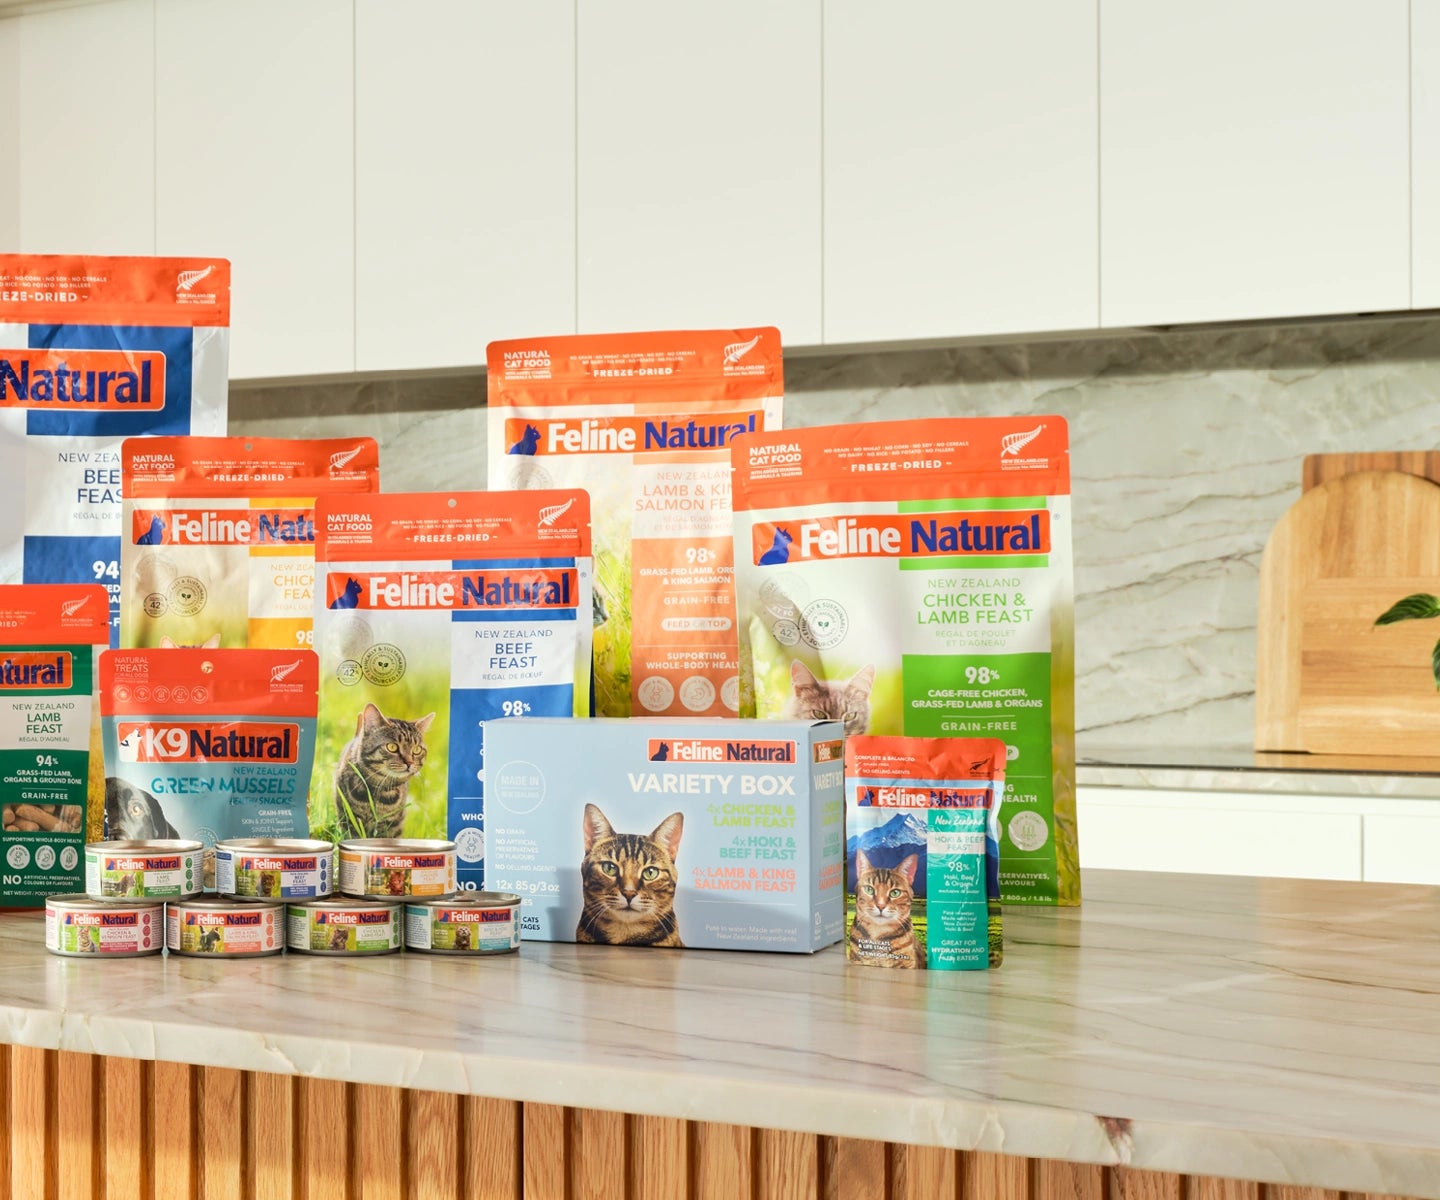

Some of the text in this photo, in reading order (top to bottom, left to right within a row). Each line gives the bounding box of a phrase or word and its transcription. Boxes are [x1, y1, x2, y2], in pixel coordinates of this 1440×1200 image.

[504, 359, 551, 368] CAT FOOD
[593, 368, 673, 377] FREEZE-DRIED
[548, 420, 635, 453] Feline
[750, 444, 800, 455] NATURAL
[750, 453, 801, 465] CAT FOOD
[851, 460, 942, 472] FREEZE-DRIED
[214, 474, 285, 482] FREEZE-DRIED
[644, 484, 704, 496] LAMB &
[636, 499, 704, 511] SALMON
[328, 514, 371, 522] NATURAL
[172, 511, 250, 542] Feline
[327, 523, 372, 531] CAT FOOD
[414, 534, 489, 542] FREEZE-DRIED
[801, 514, 1040, 557] Feline Natural
[686, 548, 715, 563] 98%
[928, 578, 1021, 588] NEW ZEALAND
[370, 572, 570, 607] Feline Natural
[664, 596, 730, 605] GRAIN-FREE
[923, 592, 1026, 607] CHICKEN &
[917, 609, 1033, 625] LAMB FEAST
[475, 629, 553, 638] NEW ZEALAND
[495, 643, 533, 654] BEEF
[489, 657, 537, 668] FEAST
[965, 667, 1000, 684] 98%
[928, 689, 1028, 698] CAGE-FREE CHICKEN,
[35, 702, 75, 710] ZEALAND
[502, 701, 531, 716] 98%
[912, 700, 1043, 709] GRASS-FED LAMB & ORGANS
[27, 713, 61, 723] LAMB
[26, 724, 63, 734] FEAST
[941, 721, 1017, 731] GRAIN-FREE
[147, 727, 291, 758] K9Natural
[673, 742, 791, 761] Feline Natural
[36, 755, 58, 766] 94%
[233, 767, 296, 776] NEW ZEALAND
[151, 778, 295, 794] GREEN MUSSELS
[628, 773, 796, 796] VARIETY BOX
[22, 792, 68, 800] GRAIN-FREE
[878, 789, 989, 807] Feline Natural
[722, 804, 796, 815] CHICKEN &
[713, 816, 797, 828] LAMB FEAST
[747, 837, 796, 848] HOKI &
[720, 848, 797, 860] BEEF FEAST
[117, 857, 179, 869] Feline Natural
[253, 857, 316, 870] Feline Natural
[384, 855, 445, 867] Feline Natural
[948, 862, 969, 871] 98%
[708, 867, 796, 880] LAMB & KING
[3, 875, 22, 885] NO
[694, 879, 797, 892] SALMON FEAST
[73, 913, 137, 925] Feline Natural
[197, 913, 260, 925] Feline Natural
[329, 911, 389, 923] Feline Natural
[451, 911, 511, 922] Feline Natural
